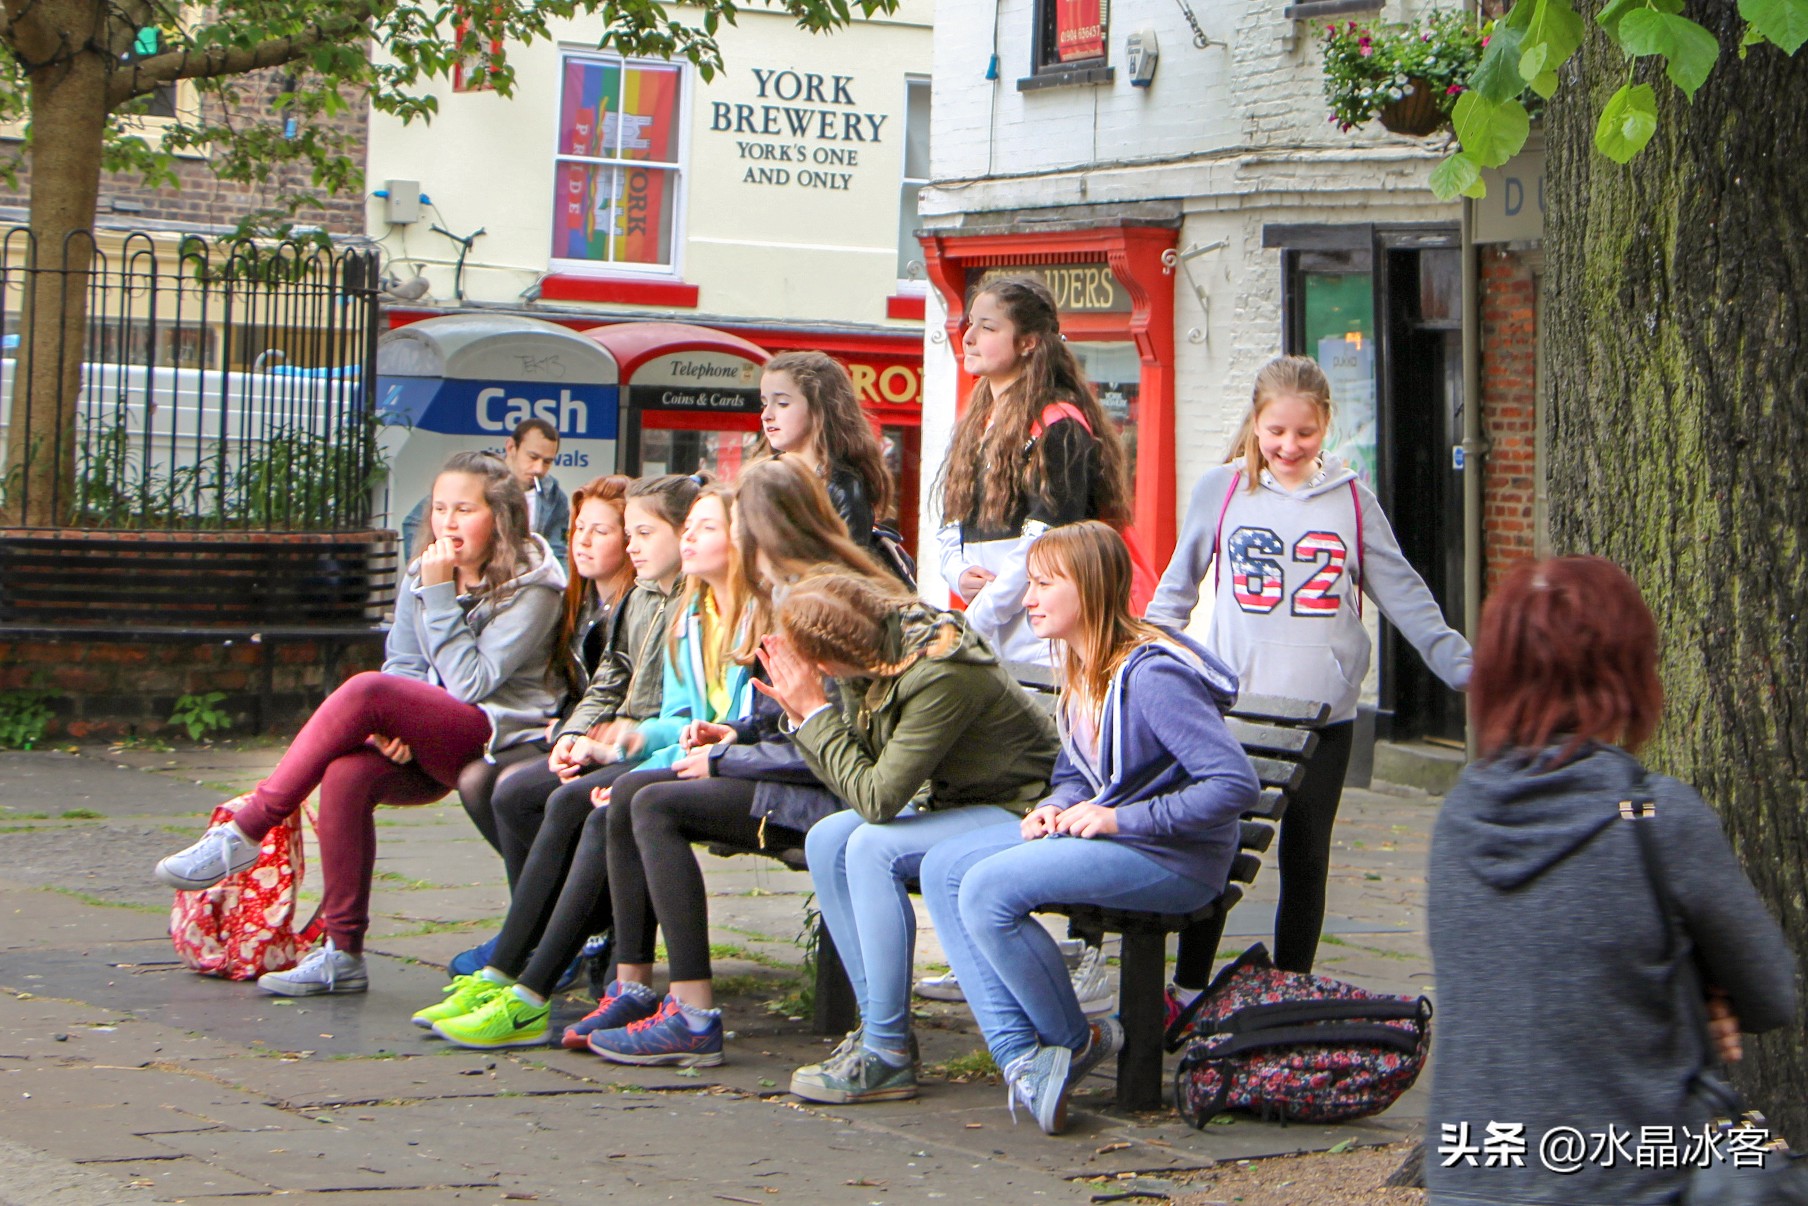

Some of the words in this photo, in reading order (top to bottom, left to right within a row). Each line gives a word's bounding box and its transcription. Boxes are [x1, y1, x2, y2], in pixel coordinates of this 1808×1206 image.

[751, 67, 856, 106] YORK
[710, 101, 888, 143] BREWERY
[568, 122, 589, 214] PRIDE
[736, 141, 807, 163] YORK'S
[812, 147, 858, 167] ONE
[743, 166, 790, 186] AND
[796, 169, 853, 191] ONLY
[670, 360, 739, 380] Telephone
[475, 387, 588, 434] Cash
[662, 391, 694, 405] Coins
[696, 392, 707, 406] &
[710, 393, 745, 407] Cards
[1228, 525, 1348, 618] 62
